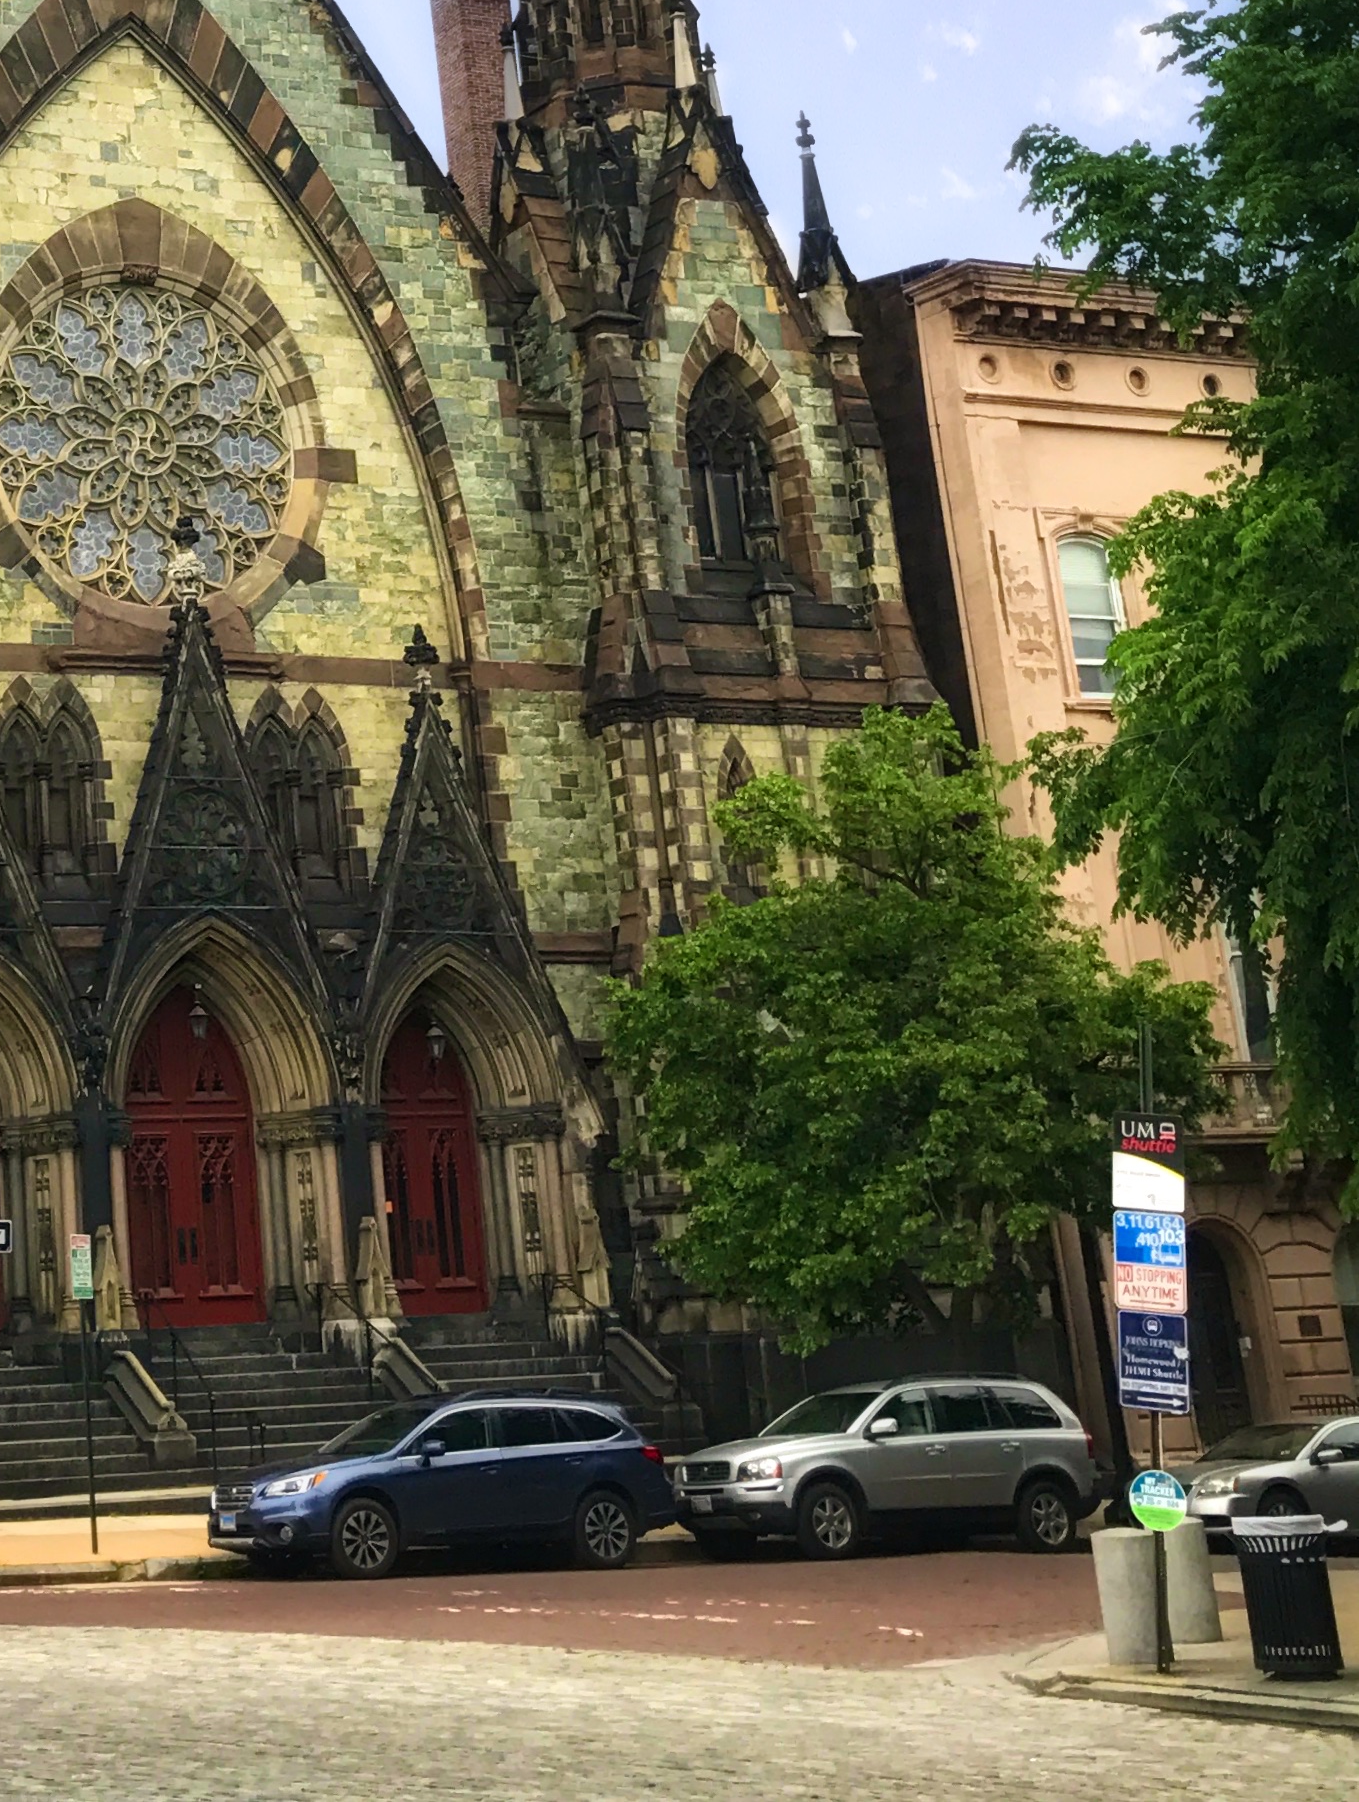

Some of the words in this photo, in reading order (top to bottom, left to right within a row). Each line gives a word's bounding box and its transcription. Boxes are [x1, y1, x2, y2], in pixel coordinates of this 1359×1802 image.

[1121, 1120, 1155, 1139] UM
[1120, 1137, 1176, 1154] shuttle
[1117, 1265, 1133, 1282] NO
[1135, 1268, 1182, 1285] STOPPING
[1122, 1284, 1180, 1301] ANYTIME
[1152, 1368, 1184, 1380] Shuttle
[1140, 1483, 1176, 1498] TRACKER
